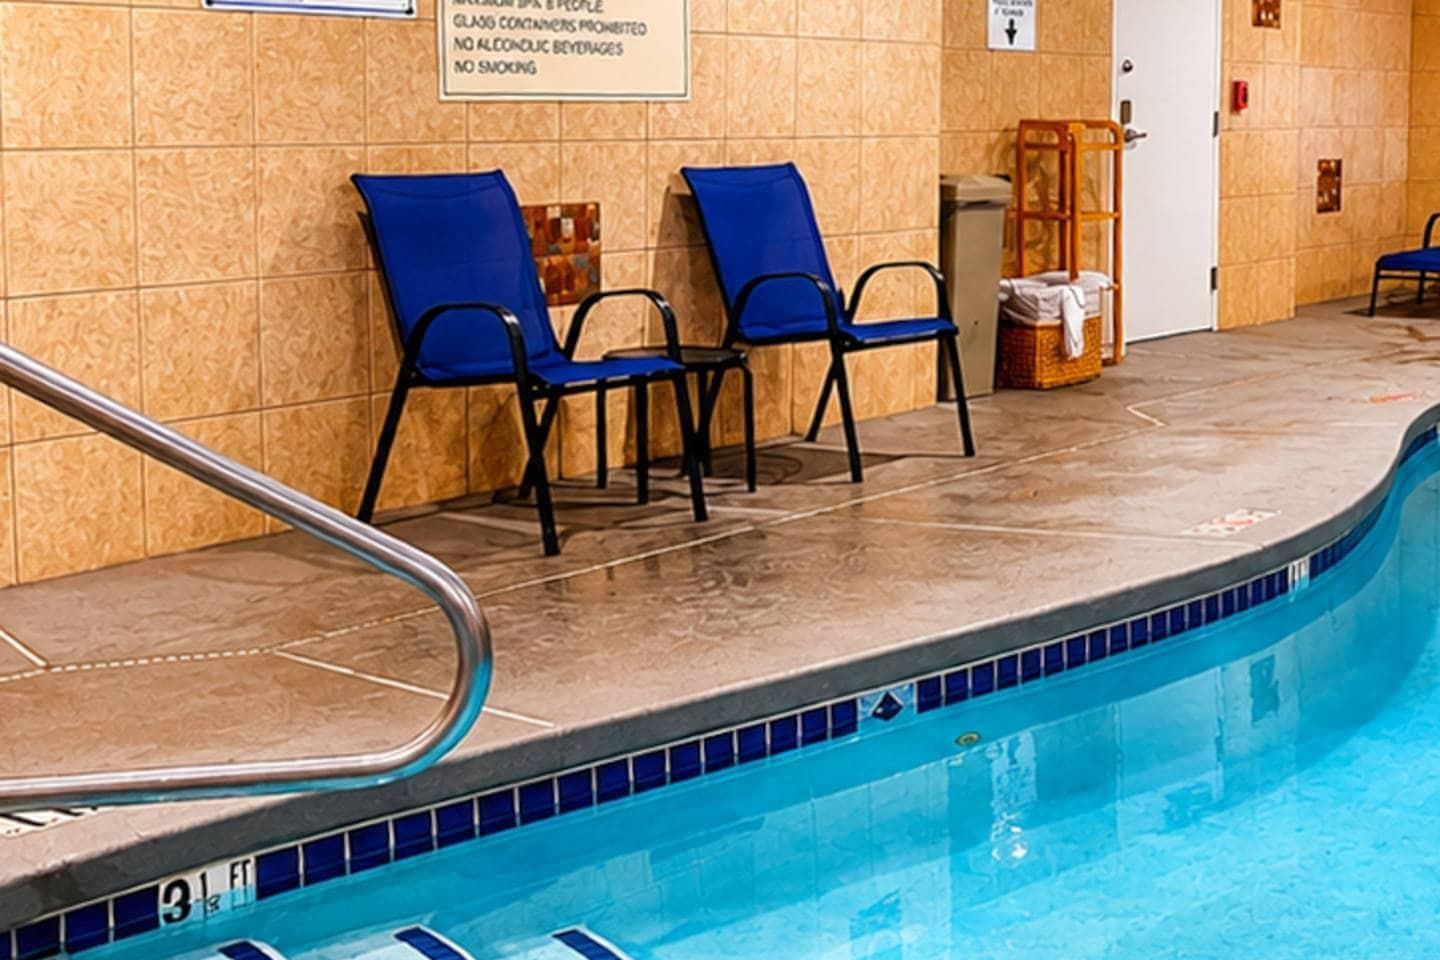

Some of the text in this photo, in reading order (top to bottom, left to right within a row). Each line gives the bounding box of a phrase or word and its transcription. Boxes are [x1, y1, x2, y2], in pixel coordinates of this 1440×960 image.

[453, 37, 474, 51] NO
[453, 60, 474, 74] NO
[230, 859, 251, 890] FT
